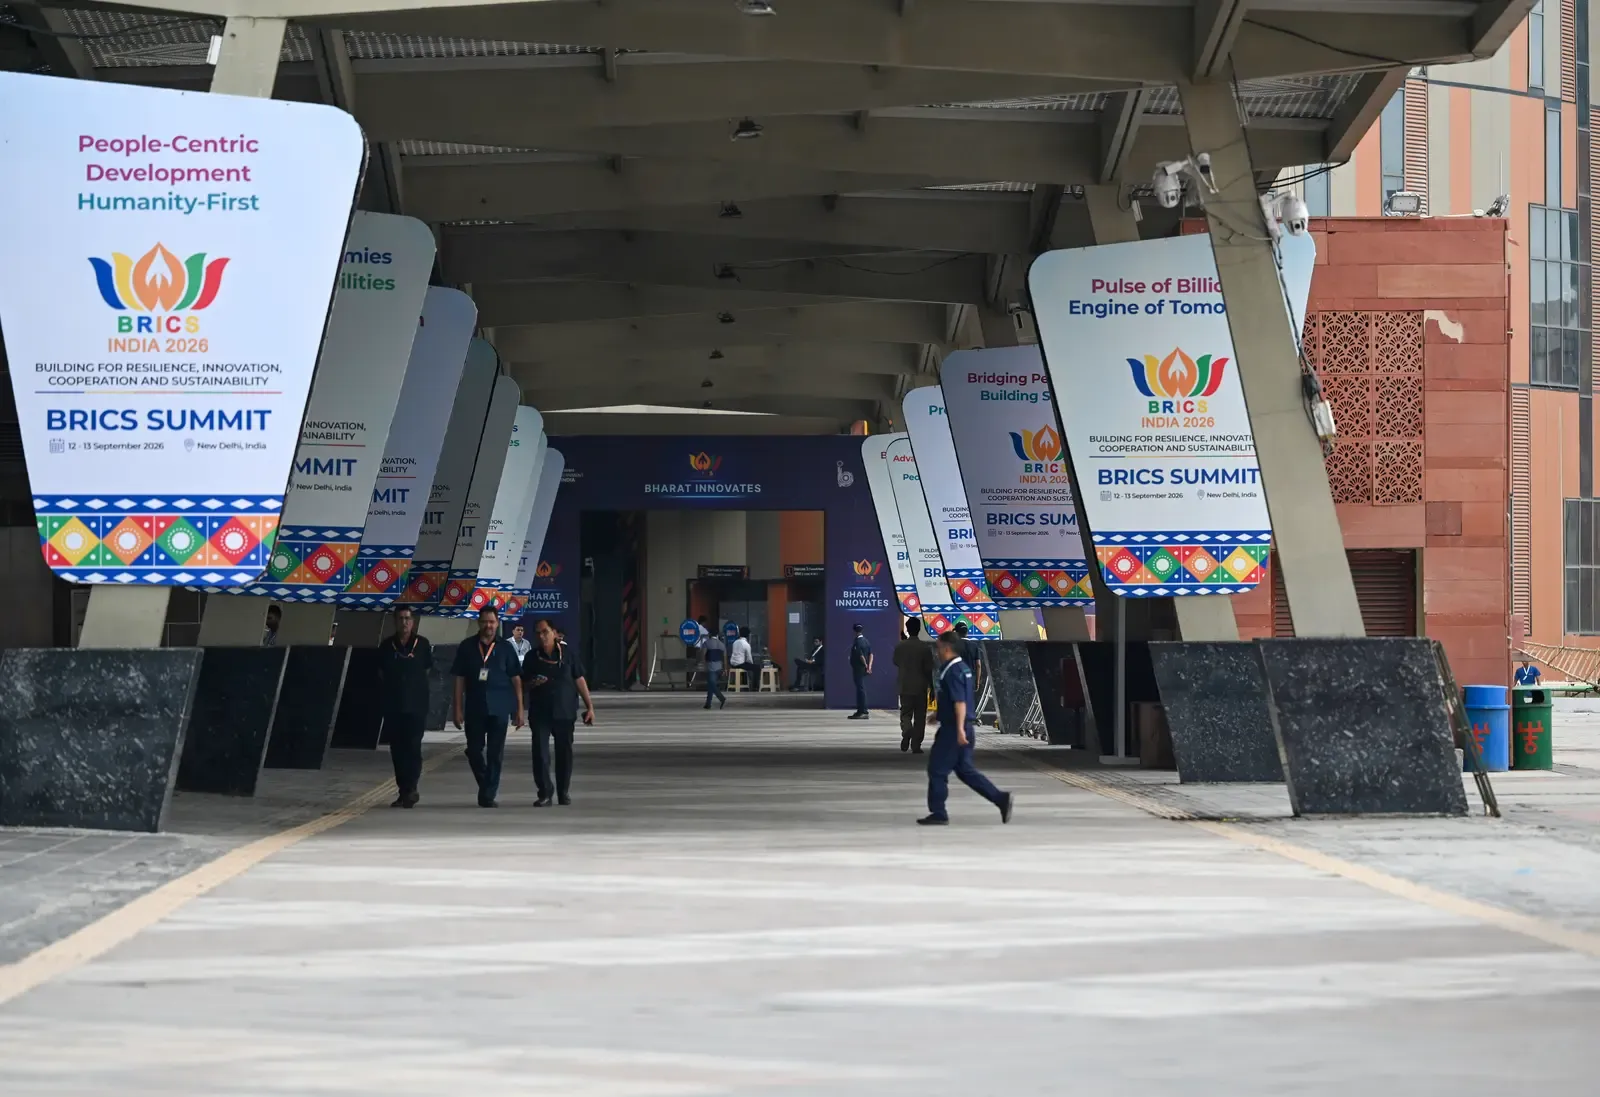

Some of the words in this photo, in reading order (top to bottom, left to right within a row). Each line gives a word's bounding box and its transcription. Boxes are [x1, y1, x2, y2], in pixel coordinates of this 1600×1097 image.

[78, 134, 258, 158] People-Centric
[86, 164, 252, 186] Development
[78, 192, 260, 214] Humanity-First
[340, 272, 396, 291] ilities
[1092, 278, 1146, 294] Pulse
[1152, 278, 1172, 294] of
[1070, 298, 1140, 318] Engine
[1144, 298, 1166, 314] of
[118, 316, 200, 334] BRICS
[108, 338, 160, 352] INDIA
[164, 338, 208, 354] 2026
[36, 362, 94, 372] BUILDING
[98, 364, 122, 372] FOR
[126, 362, 200, 374] RESILIENCE,
[202, 364, 282, 374] INNOVATION,
[48, 376, 138, 386] COOPERATION
[140, 376, 168, 386] AND
[172, 376, 268, 386] SUSTAINABILITY
[968, 372, 1027, 386] Bridging
[980, 390, 1038, 404] Building
[1148, 400, 1208, 414] BRICS
[46, 410, 138, 430] BRICS
[146, 408, 272, 432] SUMMIT
[1142, 416, 1180, 428] INDIA
[1182, 416, 1216, 428] 2026
[218, 442, 244, 450] Delhi,
[244, 442, 266, 450] India
[1154, 434, 1208, 442] RESILIENCE,
[1208, 434, 1252, 444] INNOVATI
[68, 442, 76, 450] 12
[84, 442, 92, 450] 13
[93, 442, 142, 452] September
[144, 442, 164, 450] 2026
[1098, 444, 1164, 452] COOPERATION
[1020, 475, 1048, 484] INDIA
[1098, 468, 1164, 486] BRICS
[1170, 467, 1261, 484] SUMMIT
[644, 484, 692, 492] BHARAT
[696, 484, 762, 492] INNOVATES
[986, 513, 1035, 525] BRICS
